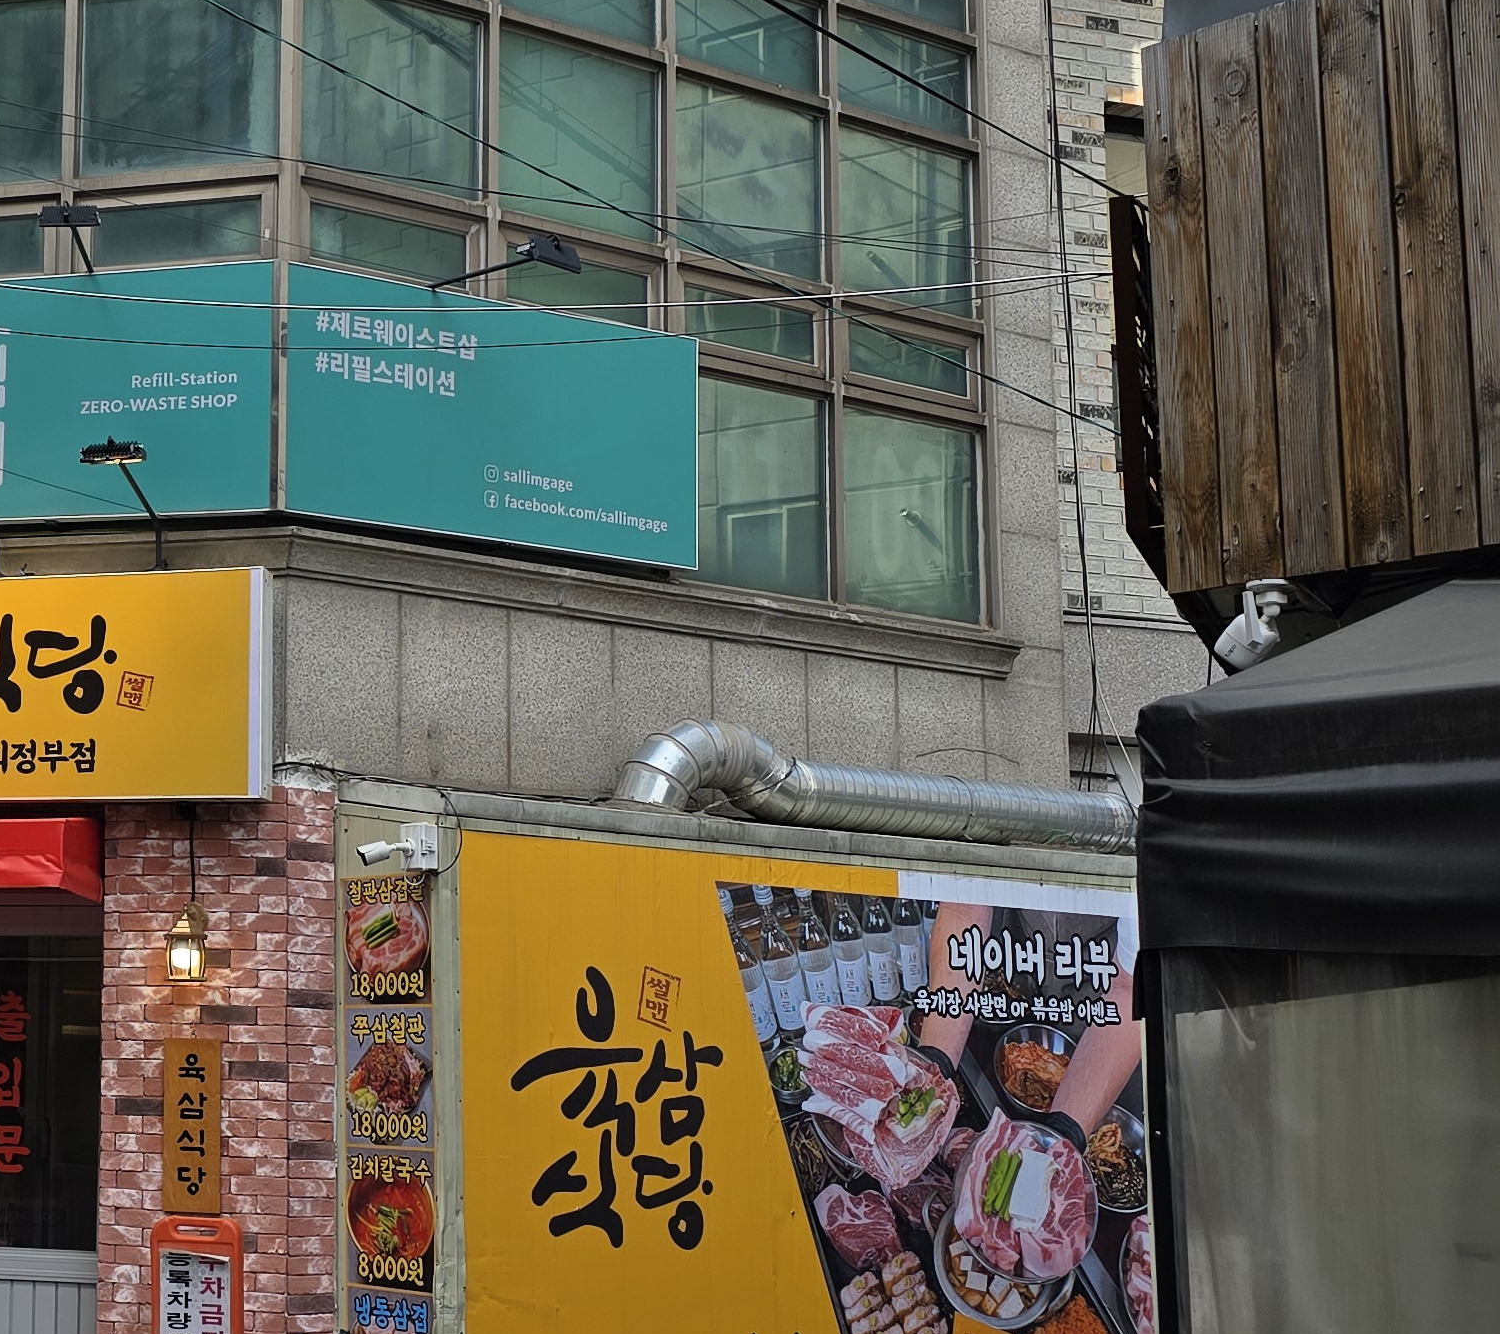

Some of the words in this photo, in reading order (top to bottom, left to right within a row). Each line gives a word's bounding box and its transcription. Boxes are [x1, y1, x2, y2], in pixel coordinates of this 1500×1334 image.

[316, 310, 478, 361] #제로웨이스트샵
[131, 370, 238, 389] Refill-Station
[315, 352, 456, 398] #리필스테이션
[79, 396, 187, 415] ZERO-WASTE
[190, 393, 238, 409] SHOP
[503, 468, 574, 493] sallimgage
[504, 493, 668, 534] facebook.com/sallimgage
[348, 876, 426, 907] 철판삼겹살
[949, 927, 1045, 987] 네이버
[1054, 935, 1118, 992] 리뷰
[351, 969, 425, 1001] 18,000원
[914, 989, 961, 1016] 육개장
[964, 992, 1008, 1021] 사발면
[1011, 1001, 1029, 1018] or
[1032, 996, 1075, 1023] 볶음밥
[1076, 999, 1121, 1026] 이벤트
[351, 1013, 426, 1046] 쭈삼철판
[176, 1052, 208, 1197] 육삼식당
[351, 1112, 428, 1143] 18,000원
[350, 1155, 432, 1186] 김치칼국수
[358, 1252, 424, 1287] 8,000원
[354, 1294, 428, 1334] 냉동삼겹
